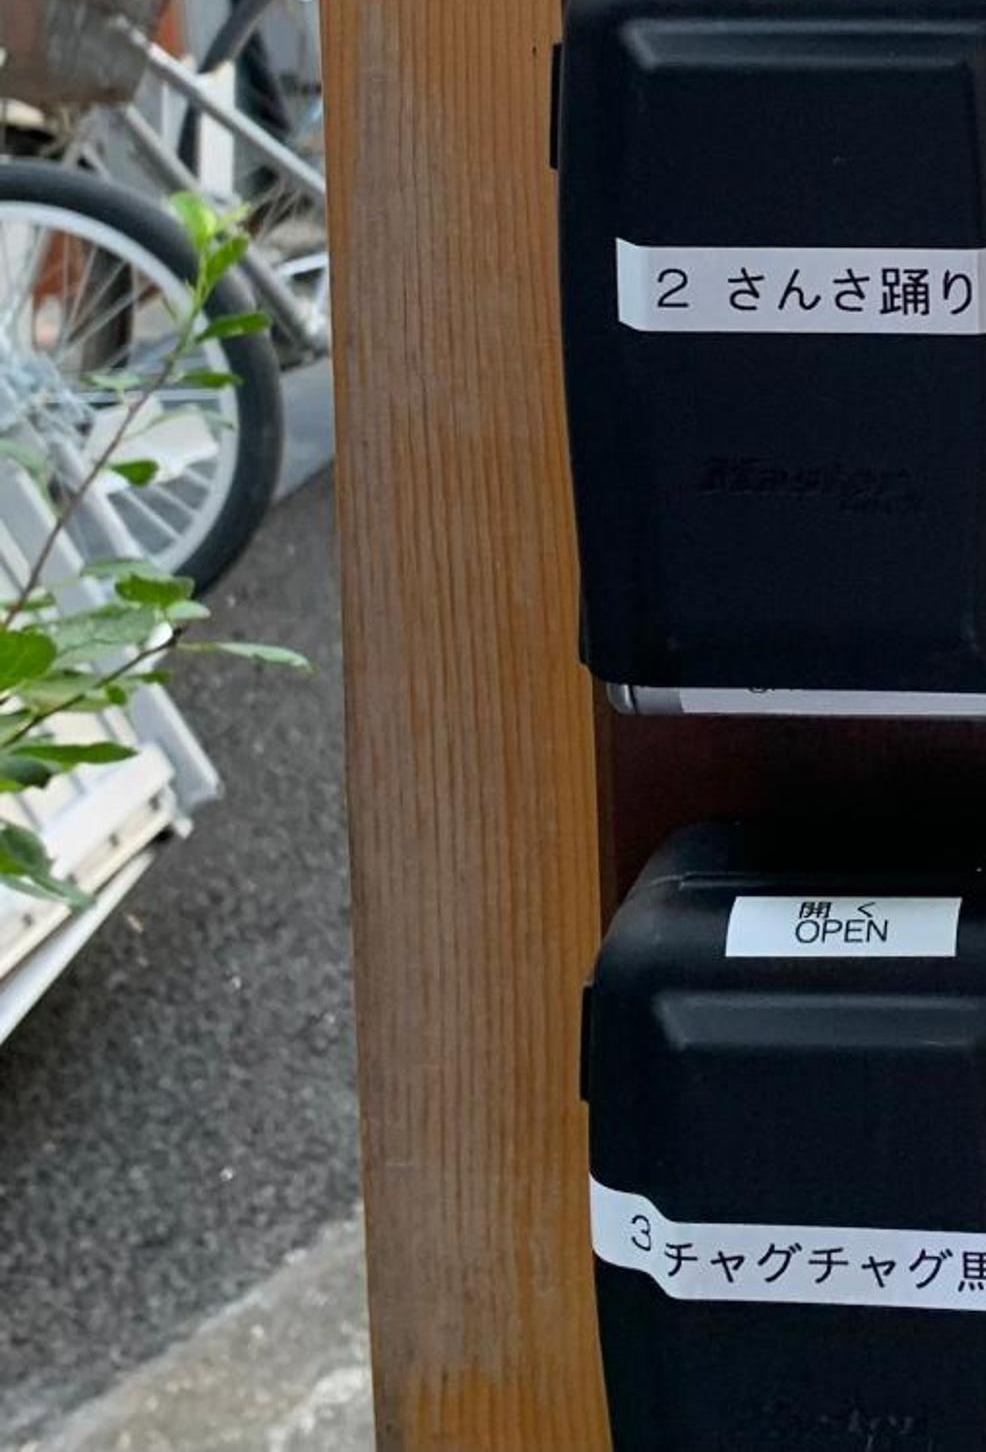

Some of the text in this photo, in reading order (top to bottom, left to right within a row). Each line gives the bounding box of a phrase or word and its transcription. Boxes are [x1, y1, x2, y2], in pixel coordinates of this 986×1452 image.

[656, 266, 974, 317] 2 さんさ踊り
[794, 919, 889, 945] OPEN
